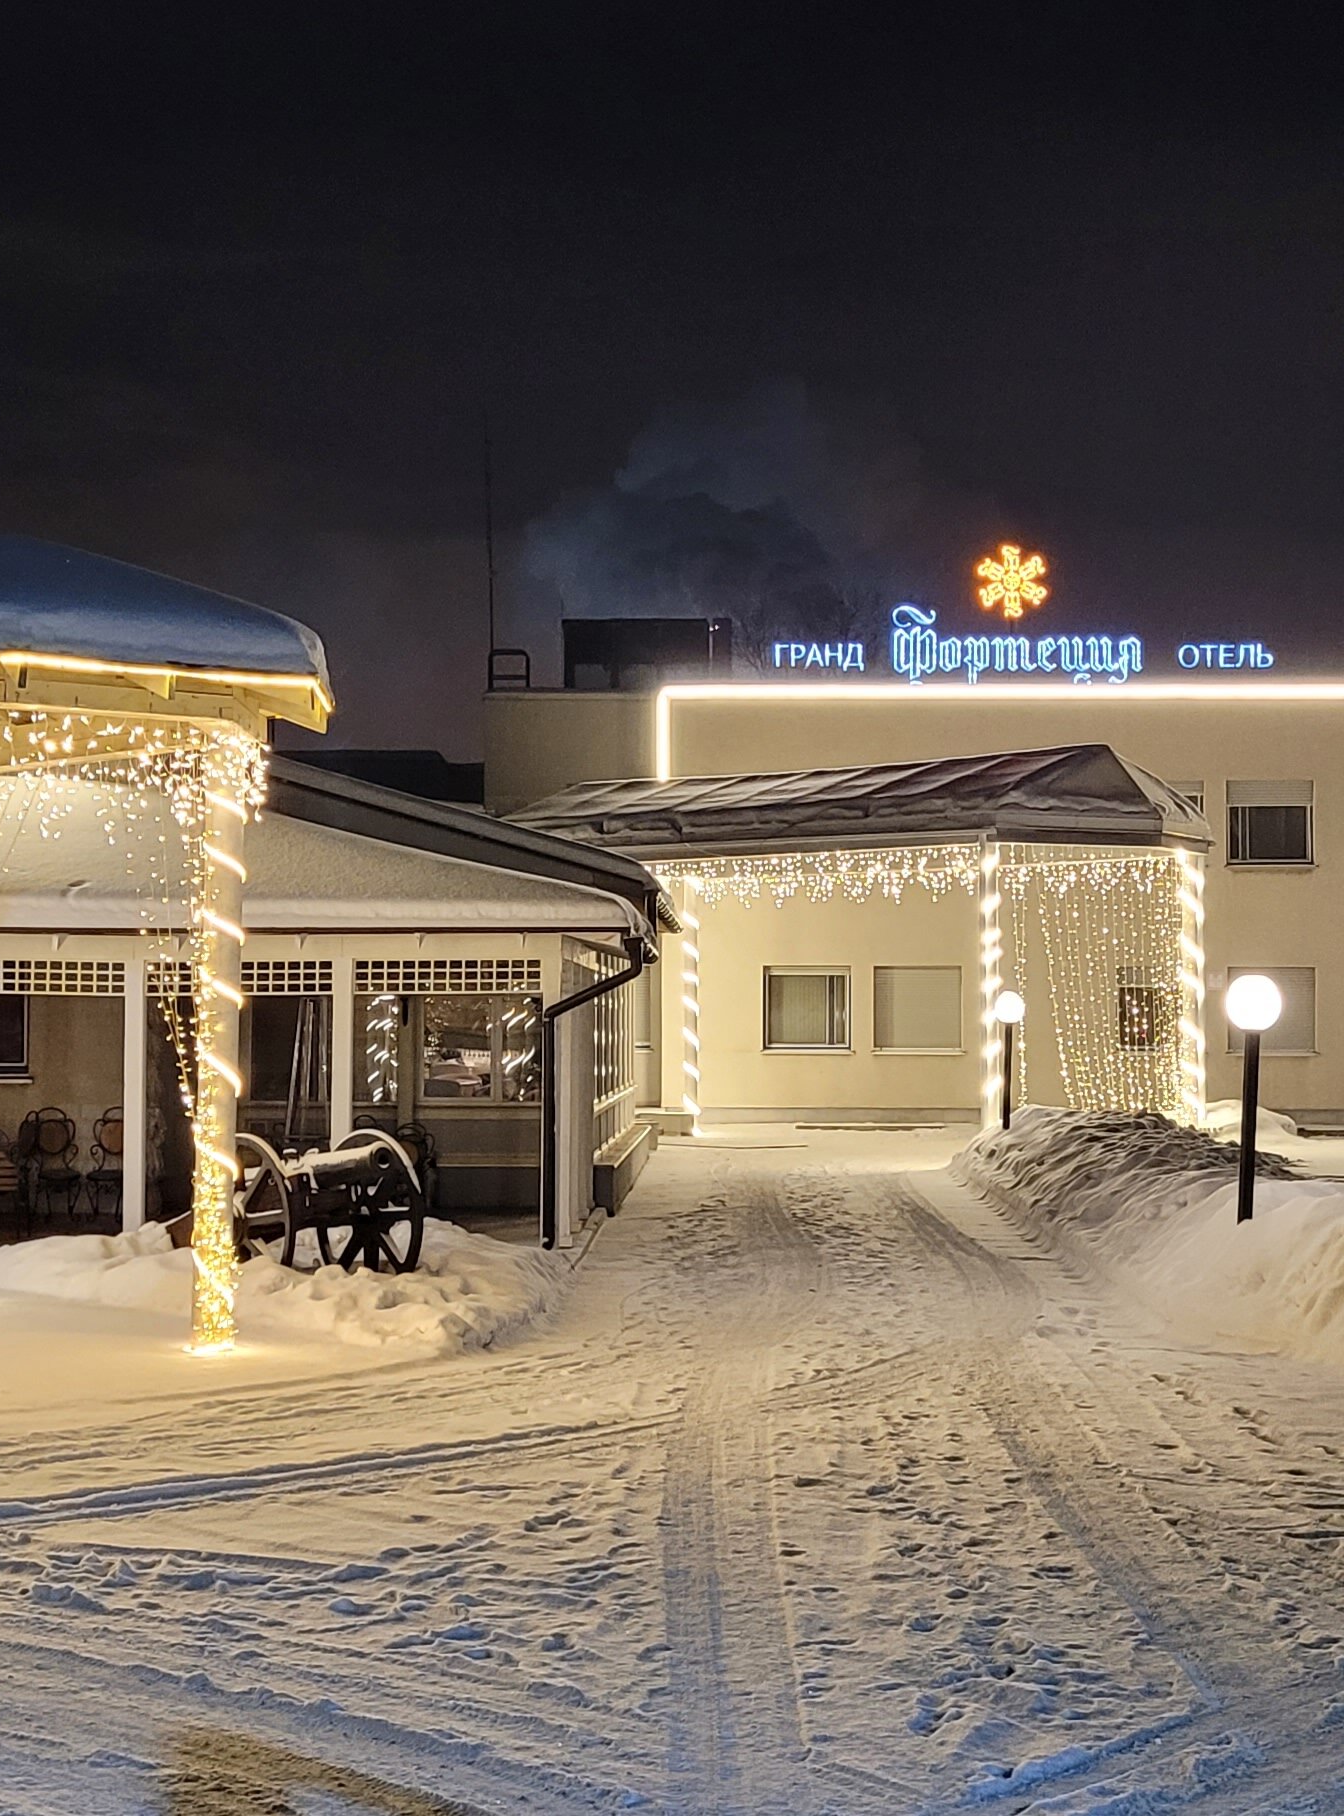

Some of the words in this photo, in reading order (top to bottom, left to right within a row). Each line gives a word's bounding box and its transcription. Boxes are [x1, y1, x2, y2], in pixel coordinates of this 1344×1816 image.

[774, 642, 865, 672] ГРАНД
[892, 605, 1144, 685] Фортеция
[1178, 643, 1274, 668] ОТЕЛЬ
